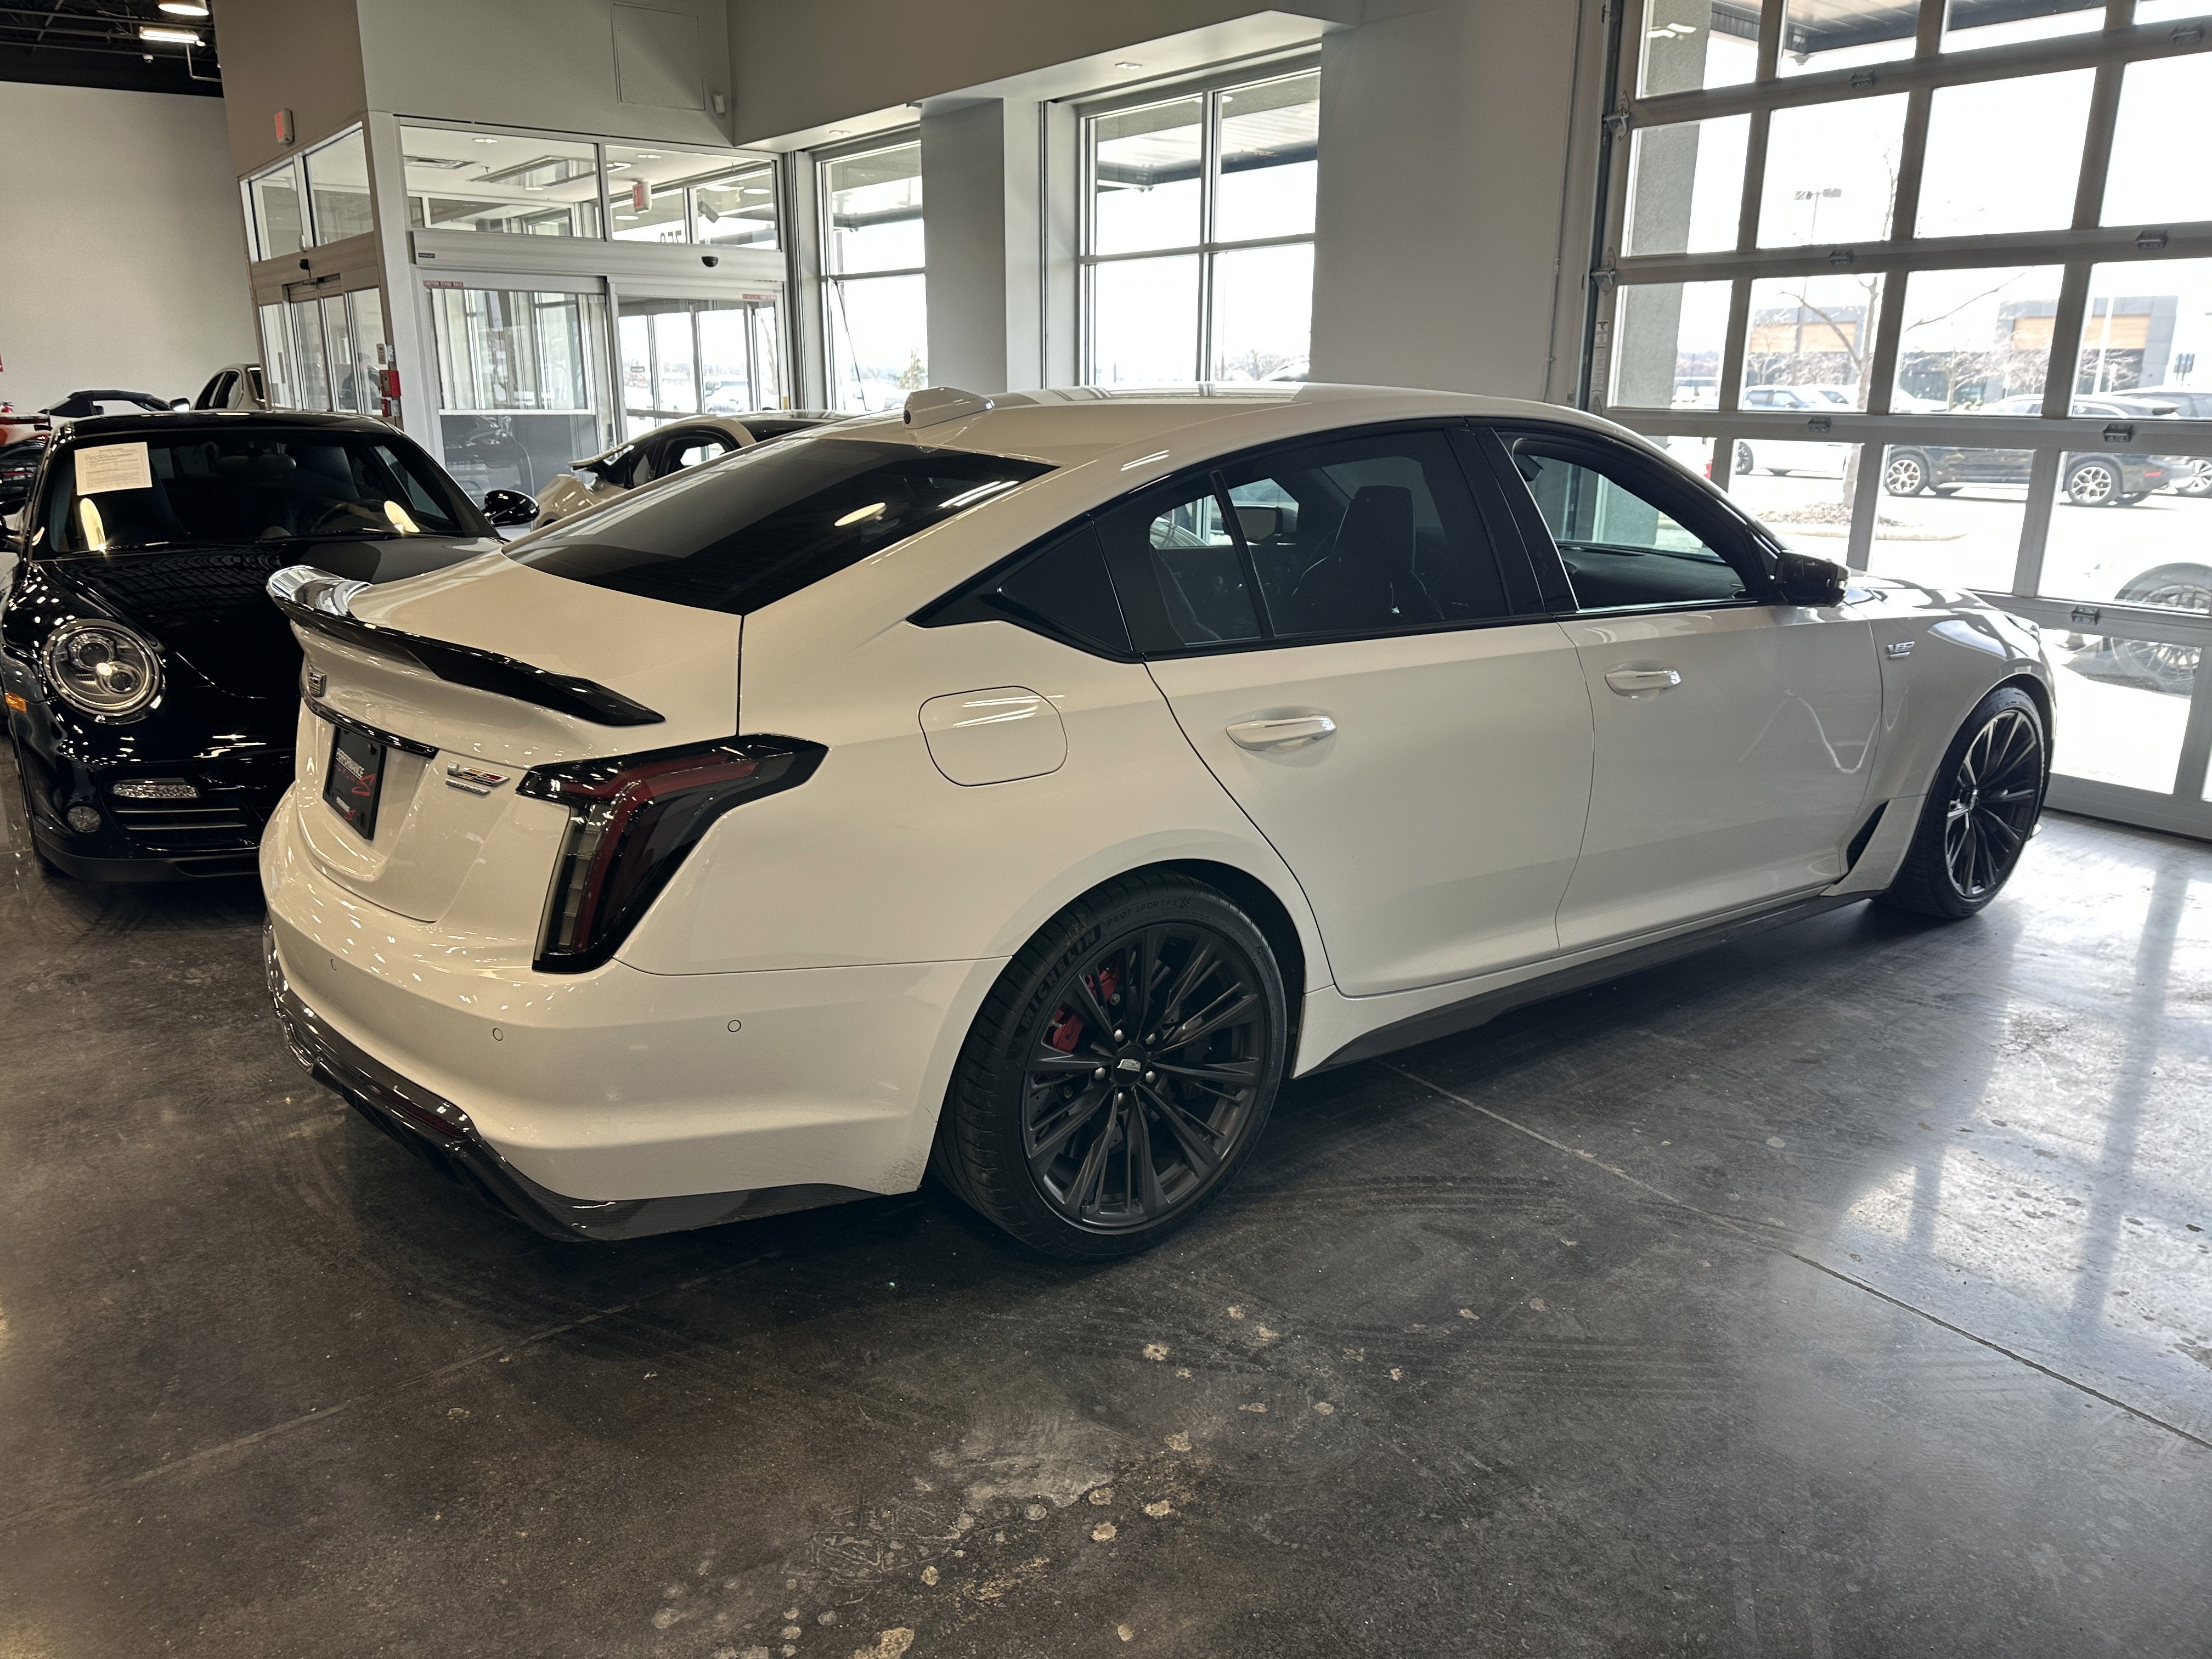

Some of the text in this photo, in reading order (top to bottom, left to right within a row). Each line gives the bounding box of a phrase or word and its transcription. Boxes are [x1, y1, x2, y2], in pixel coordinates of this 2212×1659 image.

[1107, 909, 1132, 926] PILOT
[1136, 900, 1165, 912] SPORT
[1019, 928, 1097, 1029] MICHELIN
